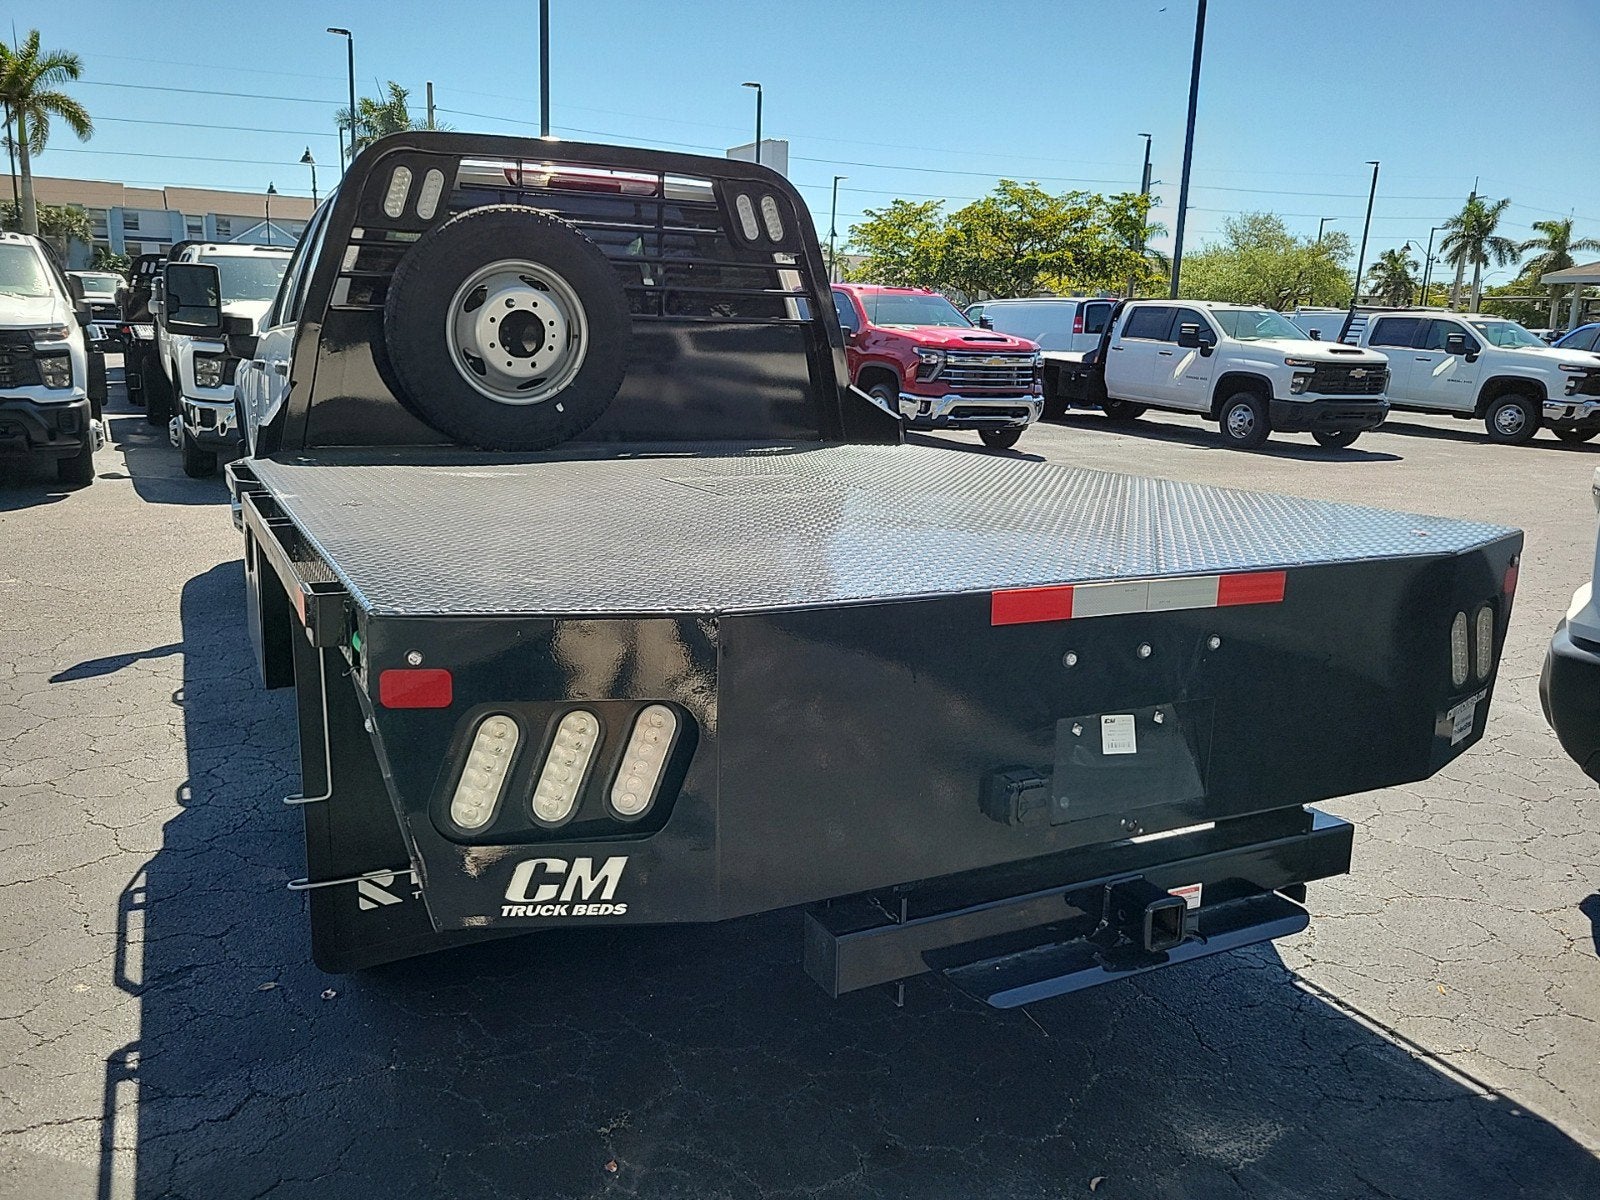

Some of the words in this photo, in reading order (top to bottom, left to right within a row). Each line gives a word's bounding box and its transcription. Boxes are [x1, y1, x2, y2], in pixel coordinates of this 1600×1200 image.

[504, 856, 629, 902] CM
[501, 904, 570, 917] TRUCK
[571, 903, 628, 916] BEDS
